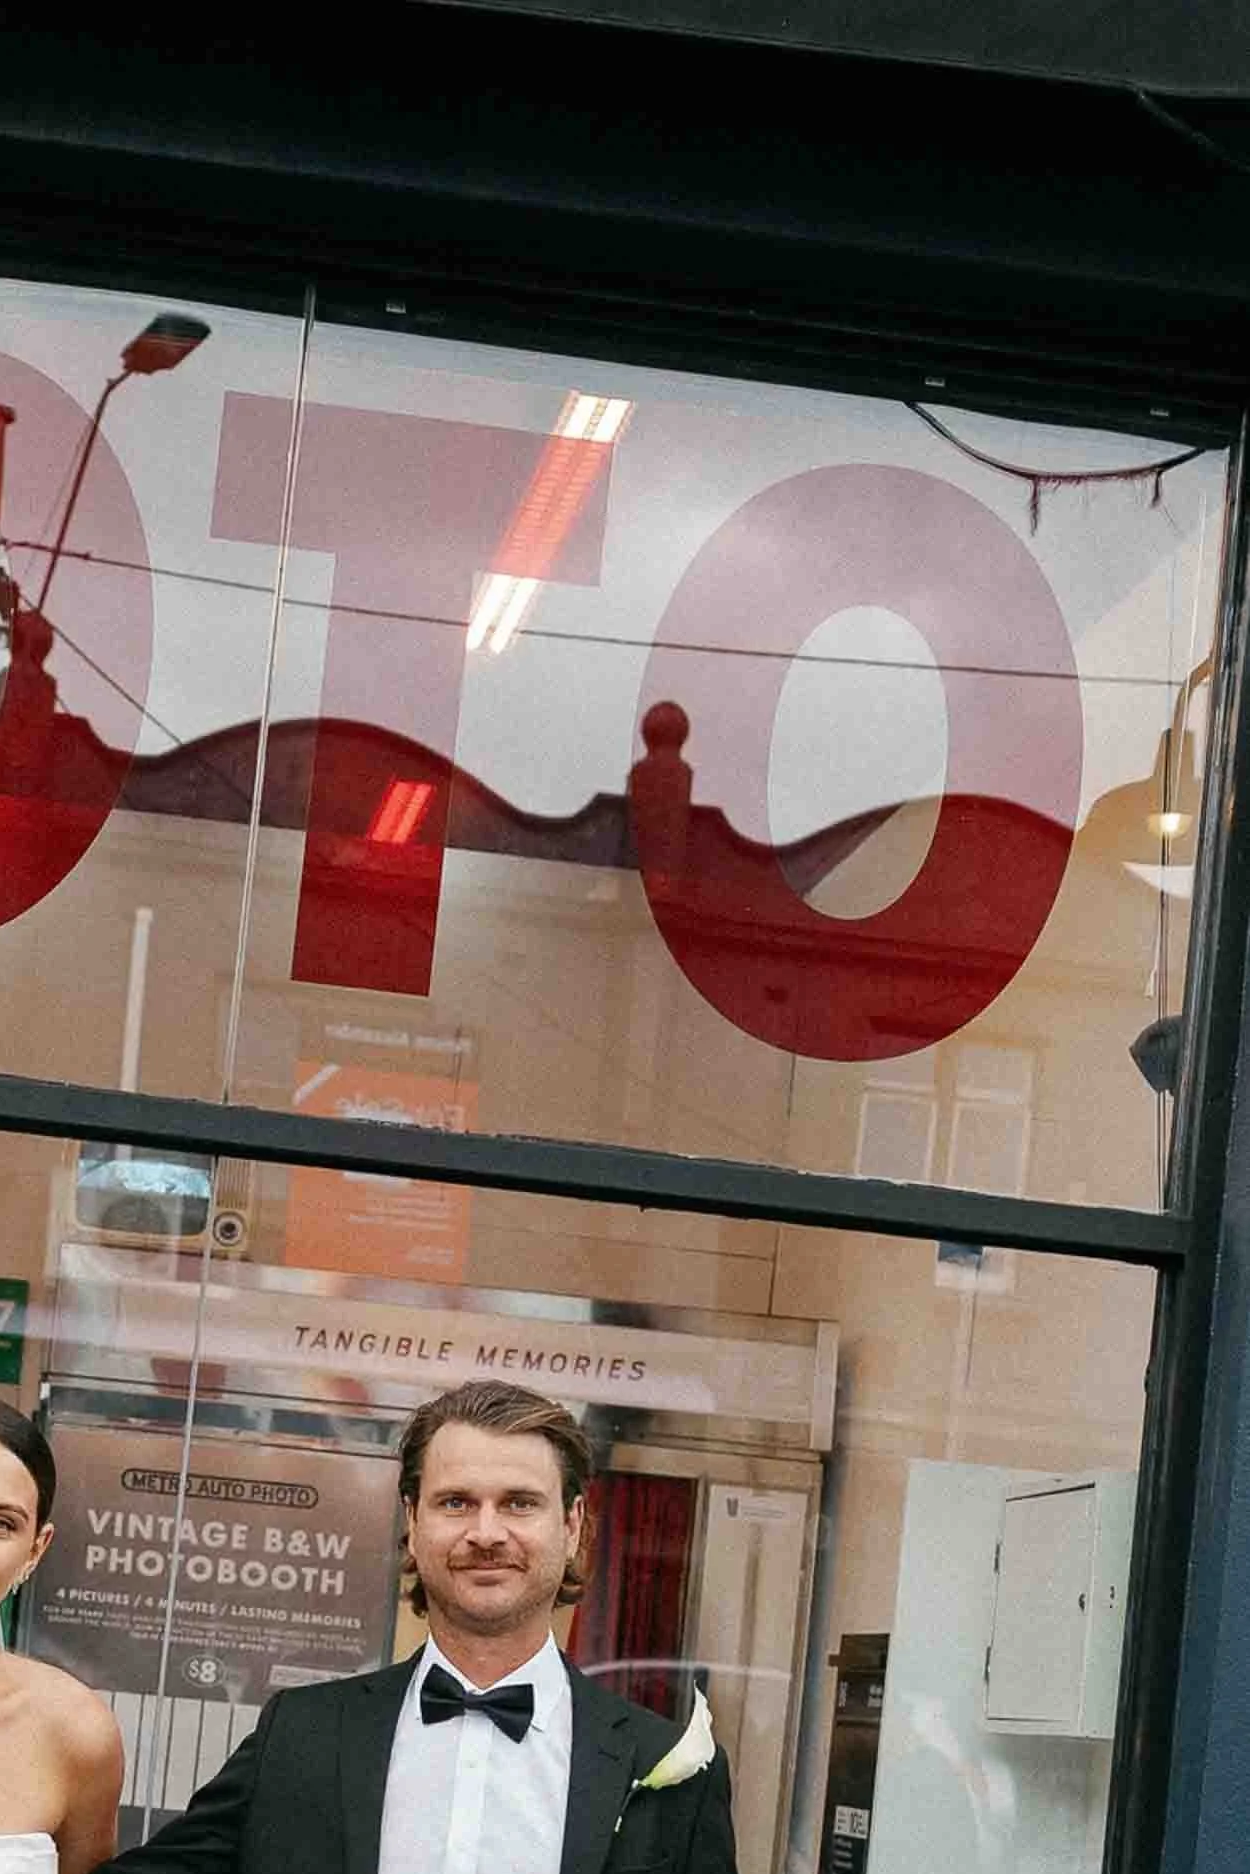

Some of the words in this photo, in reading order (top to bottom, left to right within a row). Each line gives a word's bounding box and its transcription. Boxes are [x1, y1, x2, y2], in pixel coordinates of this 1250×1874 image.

[294, 1326, 454, 1362] TANGIBLE
[475, 1345, 647, 1381] MEMORIES
[197, 1479, 246, 1498] AUTO
[251, 1484, 310, 1504] PHOTO
[87, 1509, 249, 1549] VINTAGE
[264, 1527, 351, 1560] B&W
[86, 1545, 346, 1596] PHOTOBOOTH
[56, 1587, 66, 1599] 4
[69, 1588, 130, 1605] PICTURES
[158, 1598, 217, 1615] MNUTES
[231, 1604, 288, 1622] LASTING
[291, 1610, 362, 1629] MEMORIES
[188, 1659, 218, 1683] $8
